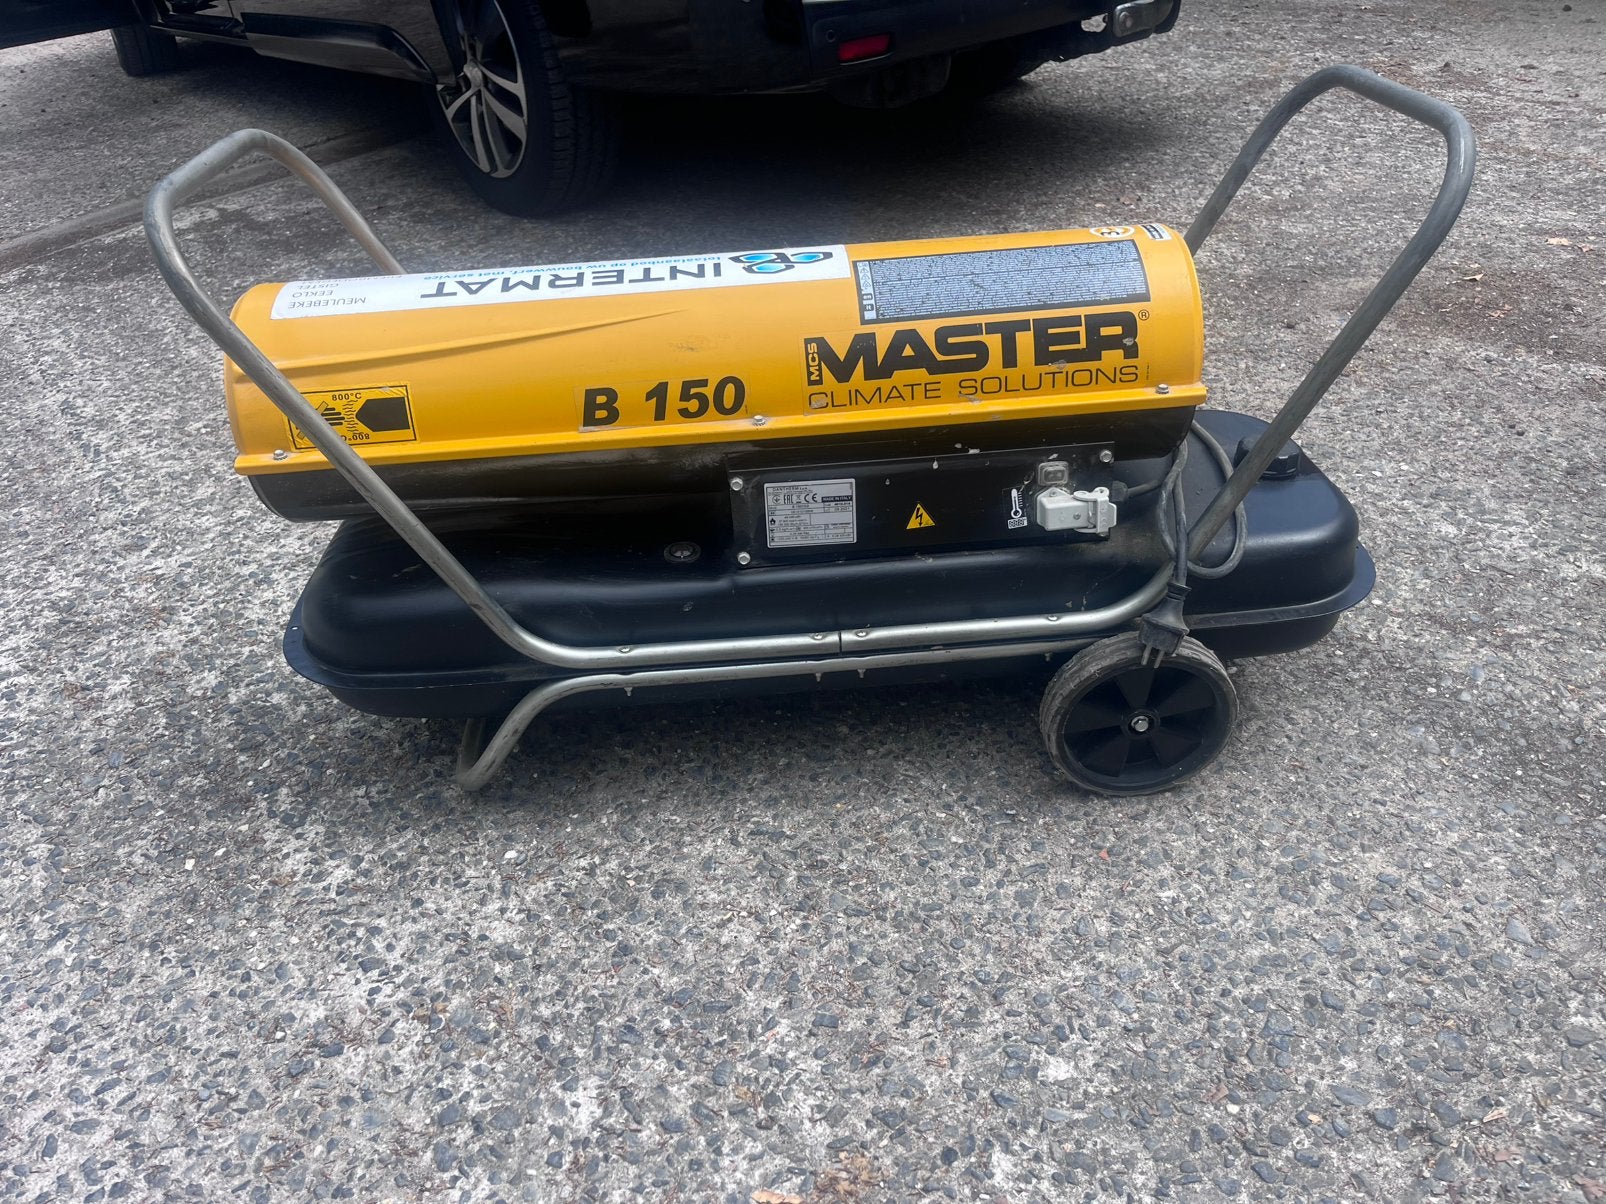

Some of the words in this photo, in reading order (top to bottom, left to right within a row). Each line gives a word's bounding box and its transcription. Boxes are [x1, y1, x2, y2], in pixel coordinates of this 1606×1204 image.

[292, 289, 333, 299] EEKLO
[421, 262, 721, 298] INTERMAT
[288, 296, 366, 309] MEULEBEKE
[807, 342, 821, 381] MCS
[820, 311, 1139, 383] MASTER
[331, 392, 362, 401] 800°C
[582, 387, 620, 427] B
[645, 376, 746, 421] 150
[809, 381, 941, 410] CLIMATE
[958, 365, 1139, 396] SOLUTIONS
